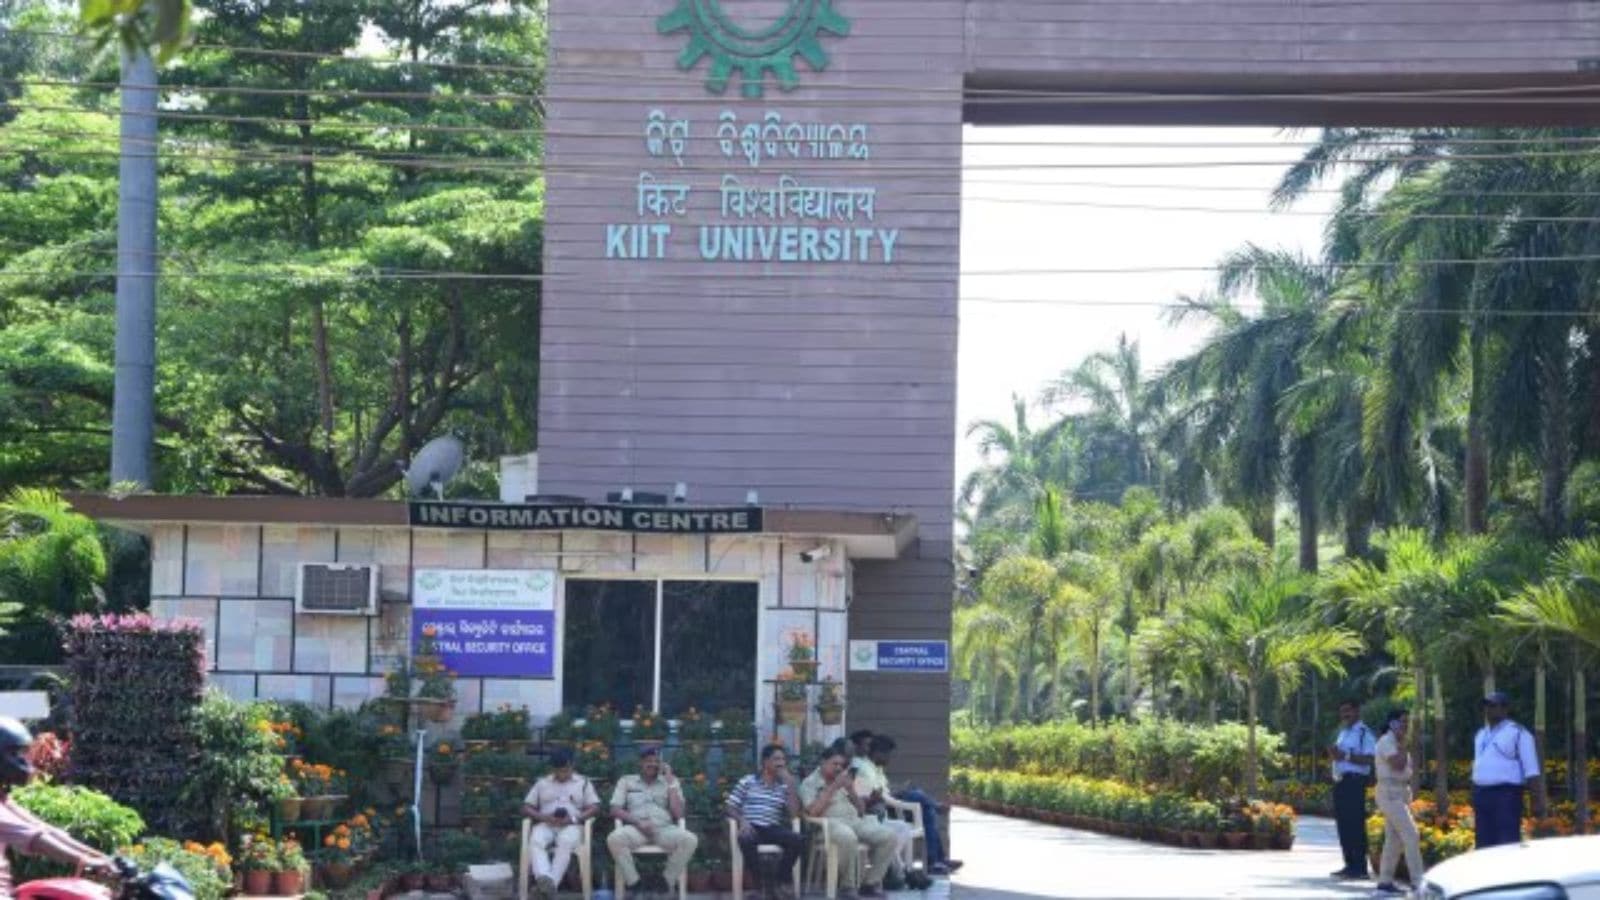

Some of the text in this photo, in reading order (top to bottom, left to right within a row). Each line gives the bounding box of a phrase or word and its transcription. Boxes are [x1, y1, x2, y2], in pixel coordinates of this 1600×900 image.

[636, 171, 691, 217] किट
[606, 223, 899, 263] KIIT UNIVERSITY
[418, 503, 749, 531] INFORMATION CENTRE
[464, 641, 510, 654] SECURITY
[511, 641, 547, 655] OFFICE
